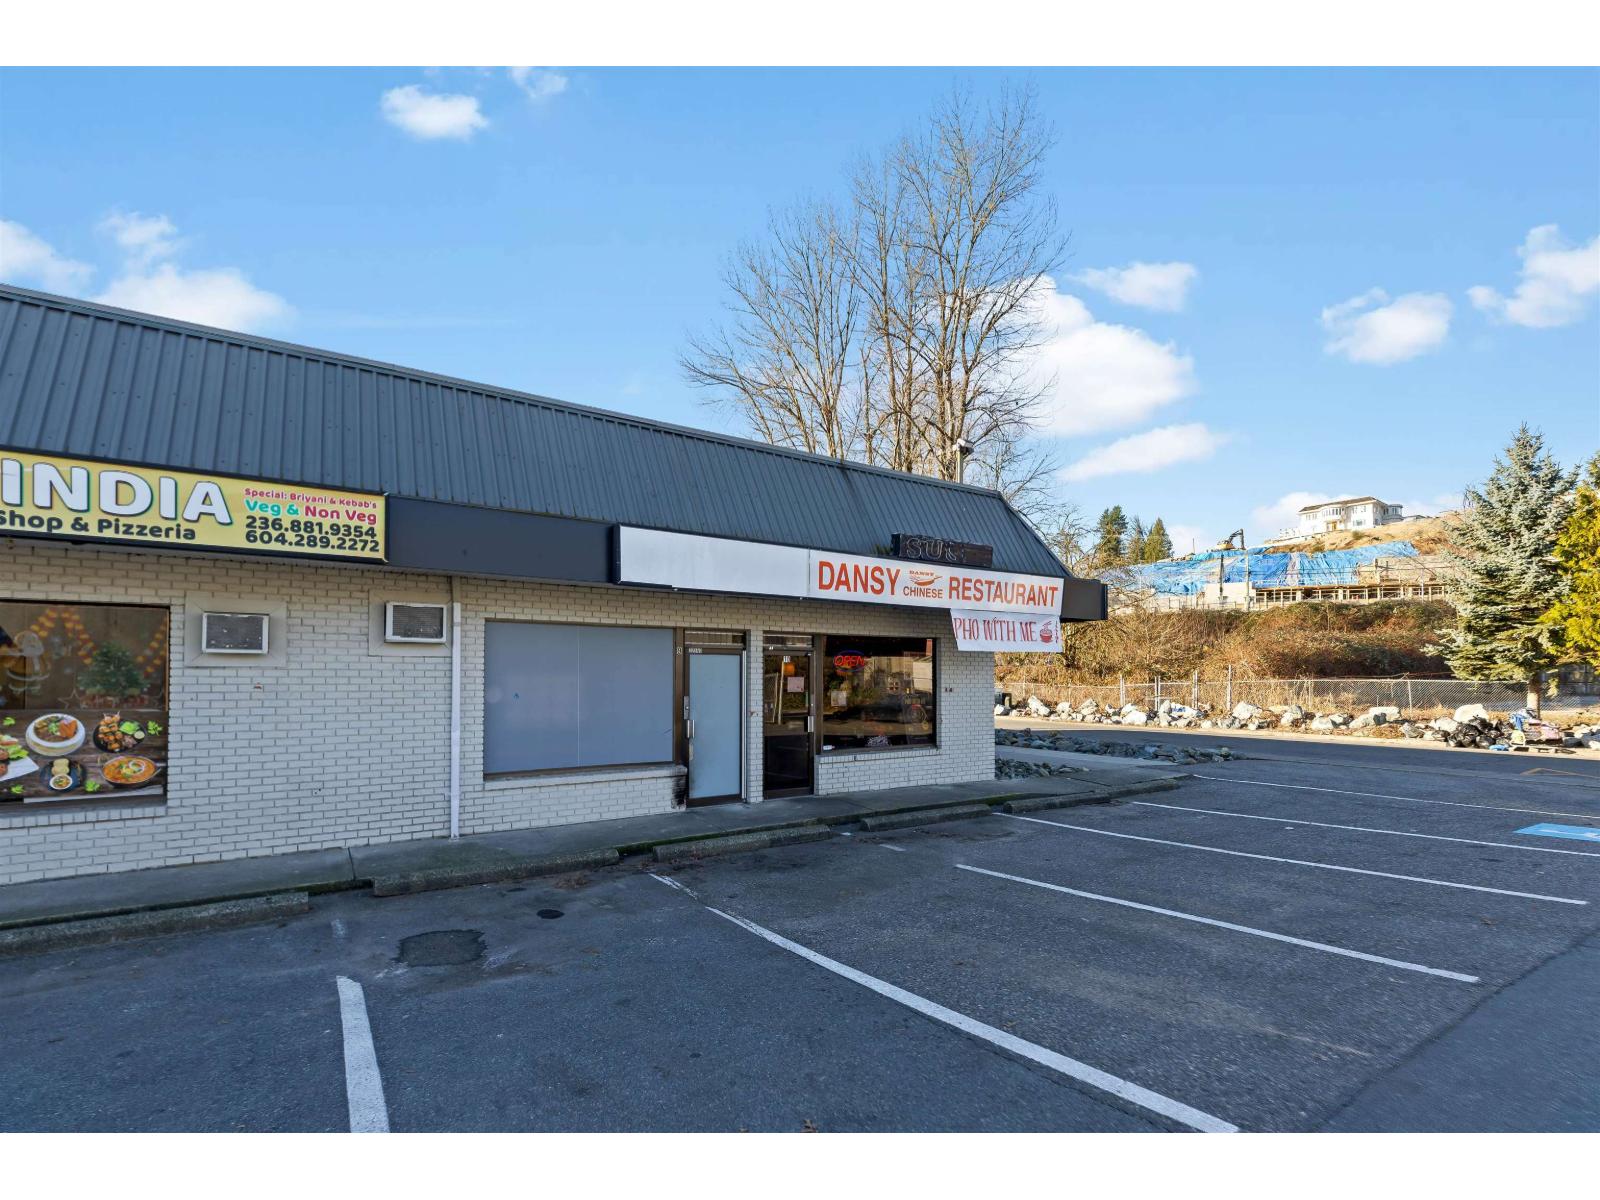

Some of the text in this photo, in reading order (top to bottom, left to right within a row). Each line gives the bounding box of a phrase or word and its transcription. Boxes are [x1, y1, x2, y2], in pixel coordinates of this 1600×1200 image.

[1, 458, 233, 525] INDIA
[245, 488, 287, 499] Special:
[339, 499, 377, 509] Kebab's
[245, 499, 377, 525] Veg & Non Veg
[71, 516, 89, 532] &
[97, 518, 196, 540] Pizzeria
[245, 515, 377, 539] 236.881.9354
[245, 529, 380, 552] 604.289.2272
[818, 560, 900, 596] DANSY
[903, 585, 943, 599] CHINESE
[948, 576, 1059, 608] RESTAURANT
[983, 618, 1017, 642] WITH
[1020, 621, 1037, 642] ME
[833, 655, 865, 668] OPEN
